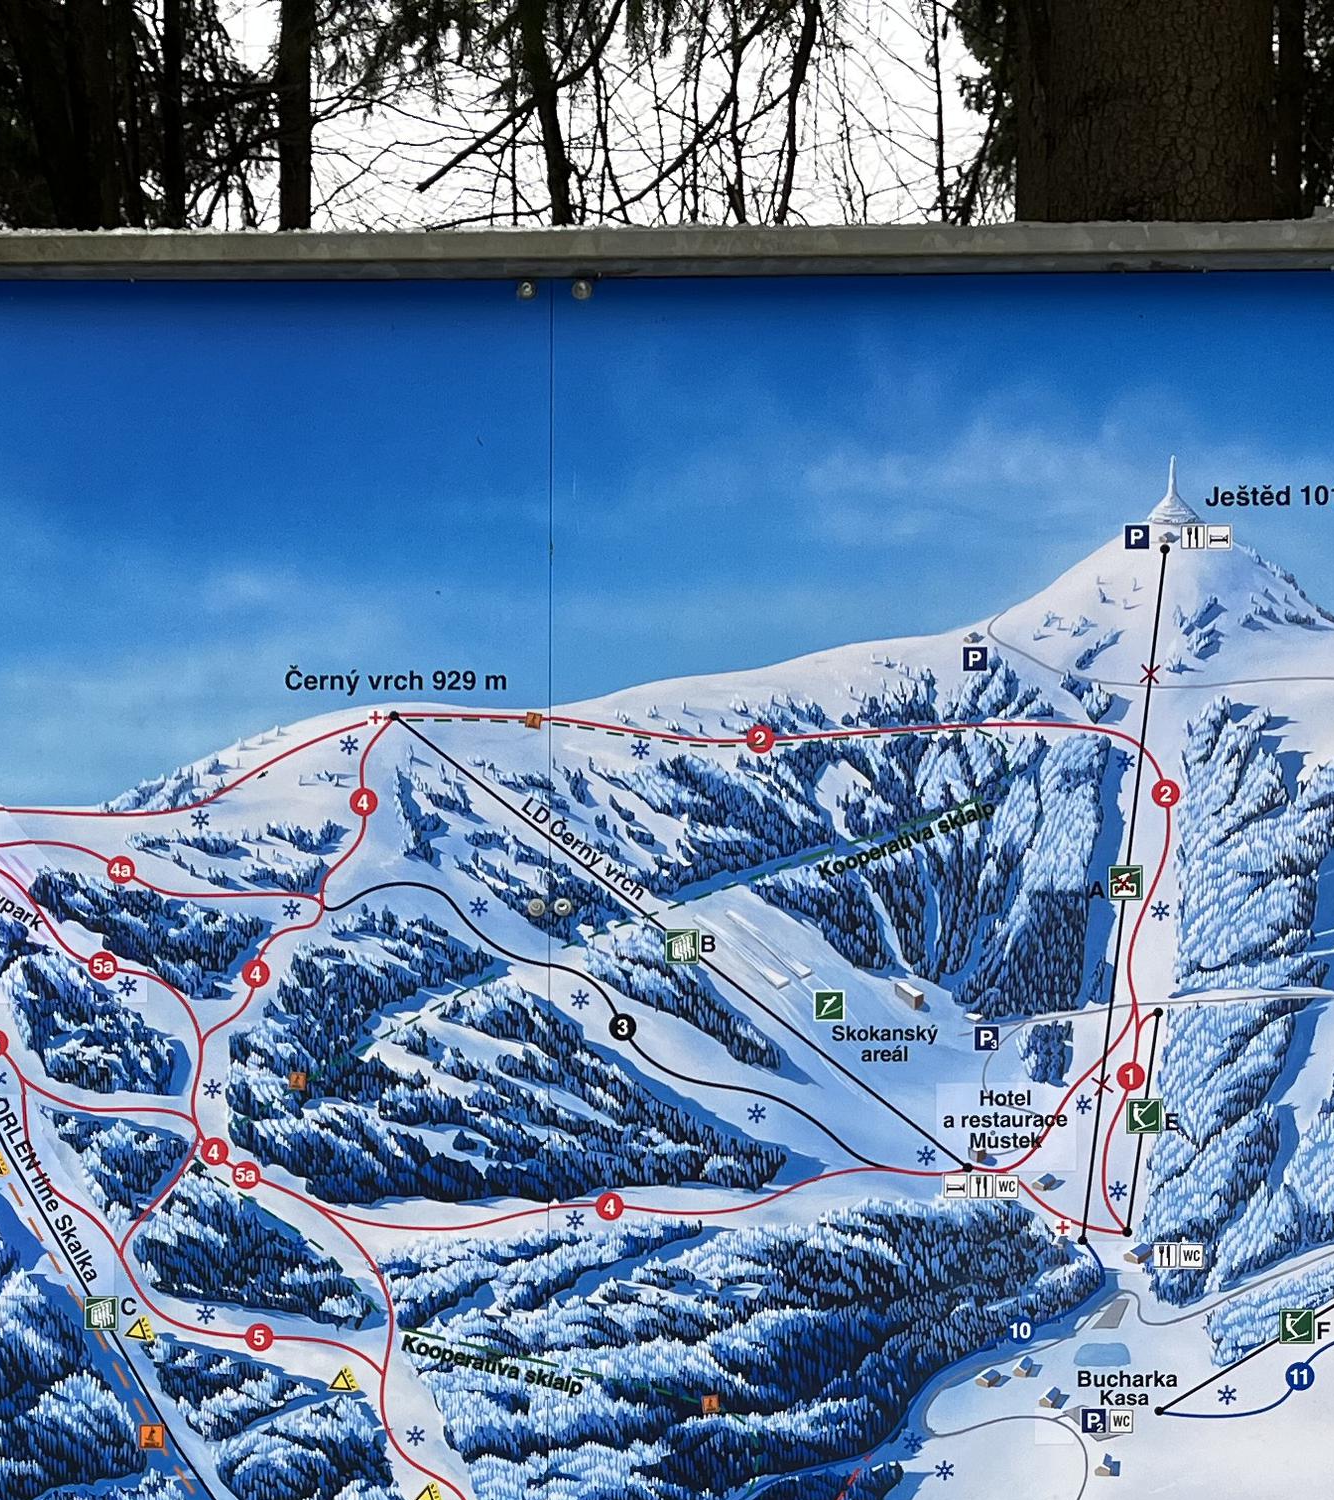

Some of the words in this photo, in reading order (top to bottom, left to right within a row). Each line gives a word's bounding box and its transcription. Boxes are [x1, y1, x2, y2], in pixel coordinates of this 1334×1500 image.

[1205, 484, 1291, 507] Ještěd
[285, 664, 360, 697] Černý
[367, 670, 424, 691] vrch
[432, 670, 477, 691] 929
[485, 674, 507, 691] m
[521, 797, 550, 824] LD
[605, 862, 645, 901] vrch
[817, 824, 935, 880] Kooperativa
[937, 802, 995, 834] skialp
[109, 863, 132, 877] 4a
[91, 959, 115, 974] 5a
[831, 1024, 939, 1050] Skokanský
[860, 1044, 909, 1063] areál
[979, 1089, 1032, 1107] Hotel
[943, 1114, 955, 1128] a
[961, 1112, 1068, 1129] restaurace
[969, 1130, 1042, 1149] Můstek
[54, 1214, 98, 1283] Skalka
[1009, 1322, 1032, 1339] 10
[401, 1334, 520, 1380] Kooperativa
[524, 1368, 584, 1398] skialp
[1077, 1369, 1178, 1388] Bucharka
[1099, 1389, 1149, 1407] Kasa
